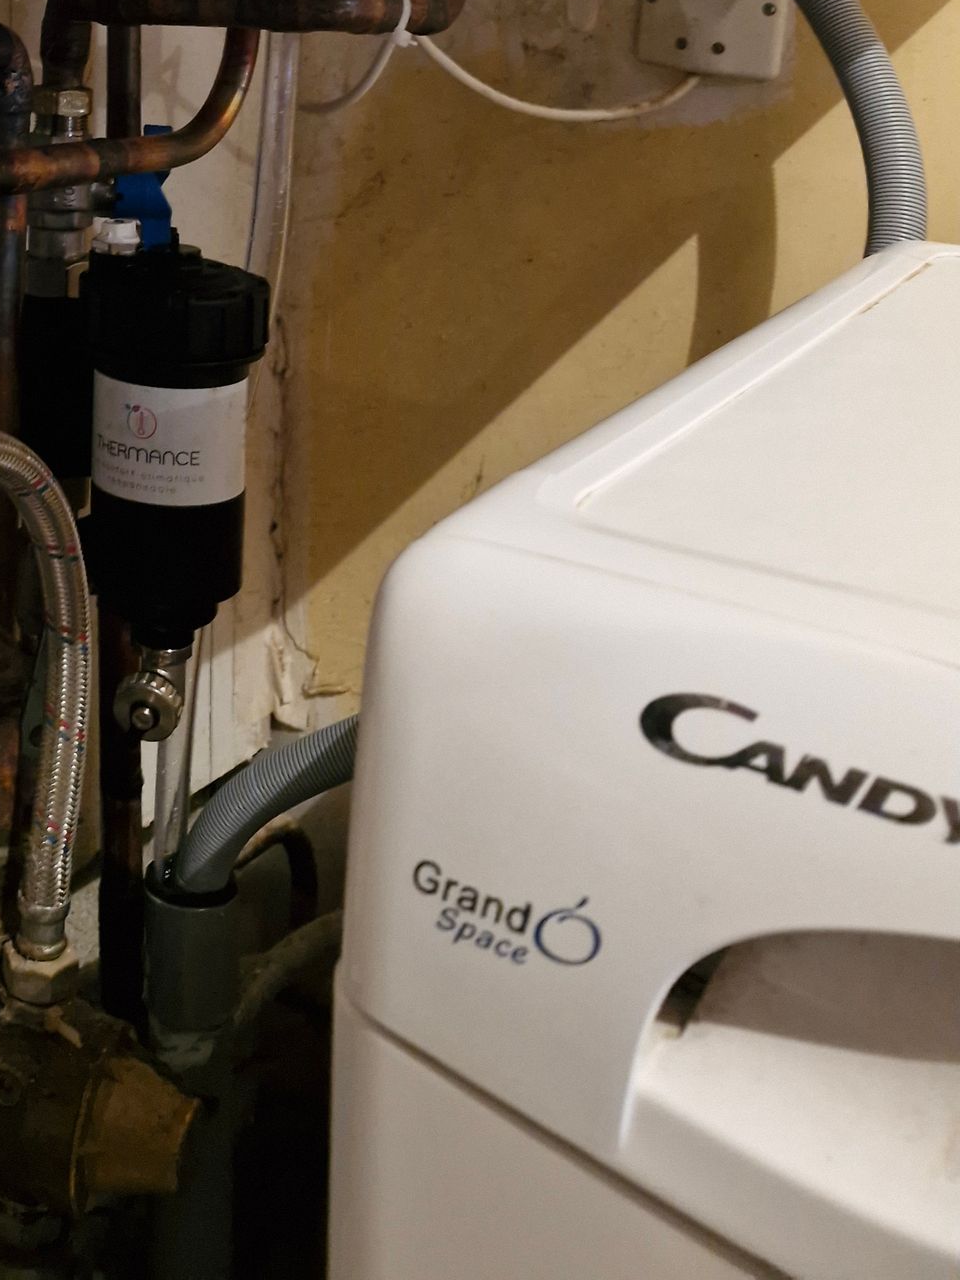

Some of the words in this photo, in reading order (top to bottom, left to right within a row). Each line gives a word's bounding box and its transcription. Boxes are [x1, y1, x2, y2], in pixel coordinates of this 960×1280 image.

[96, 433, 201, 467] THERMANCE
[639, 692, 960, 845] CANDY
[411, 858, 533, 935] Grand
[435, 906, 530, 966] Space
